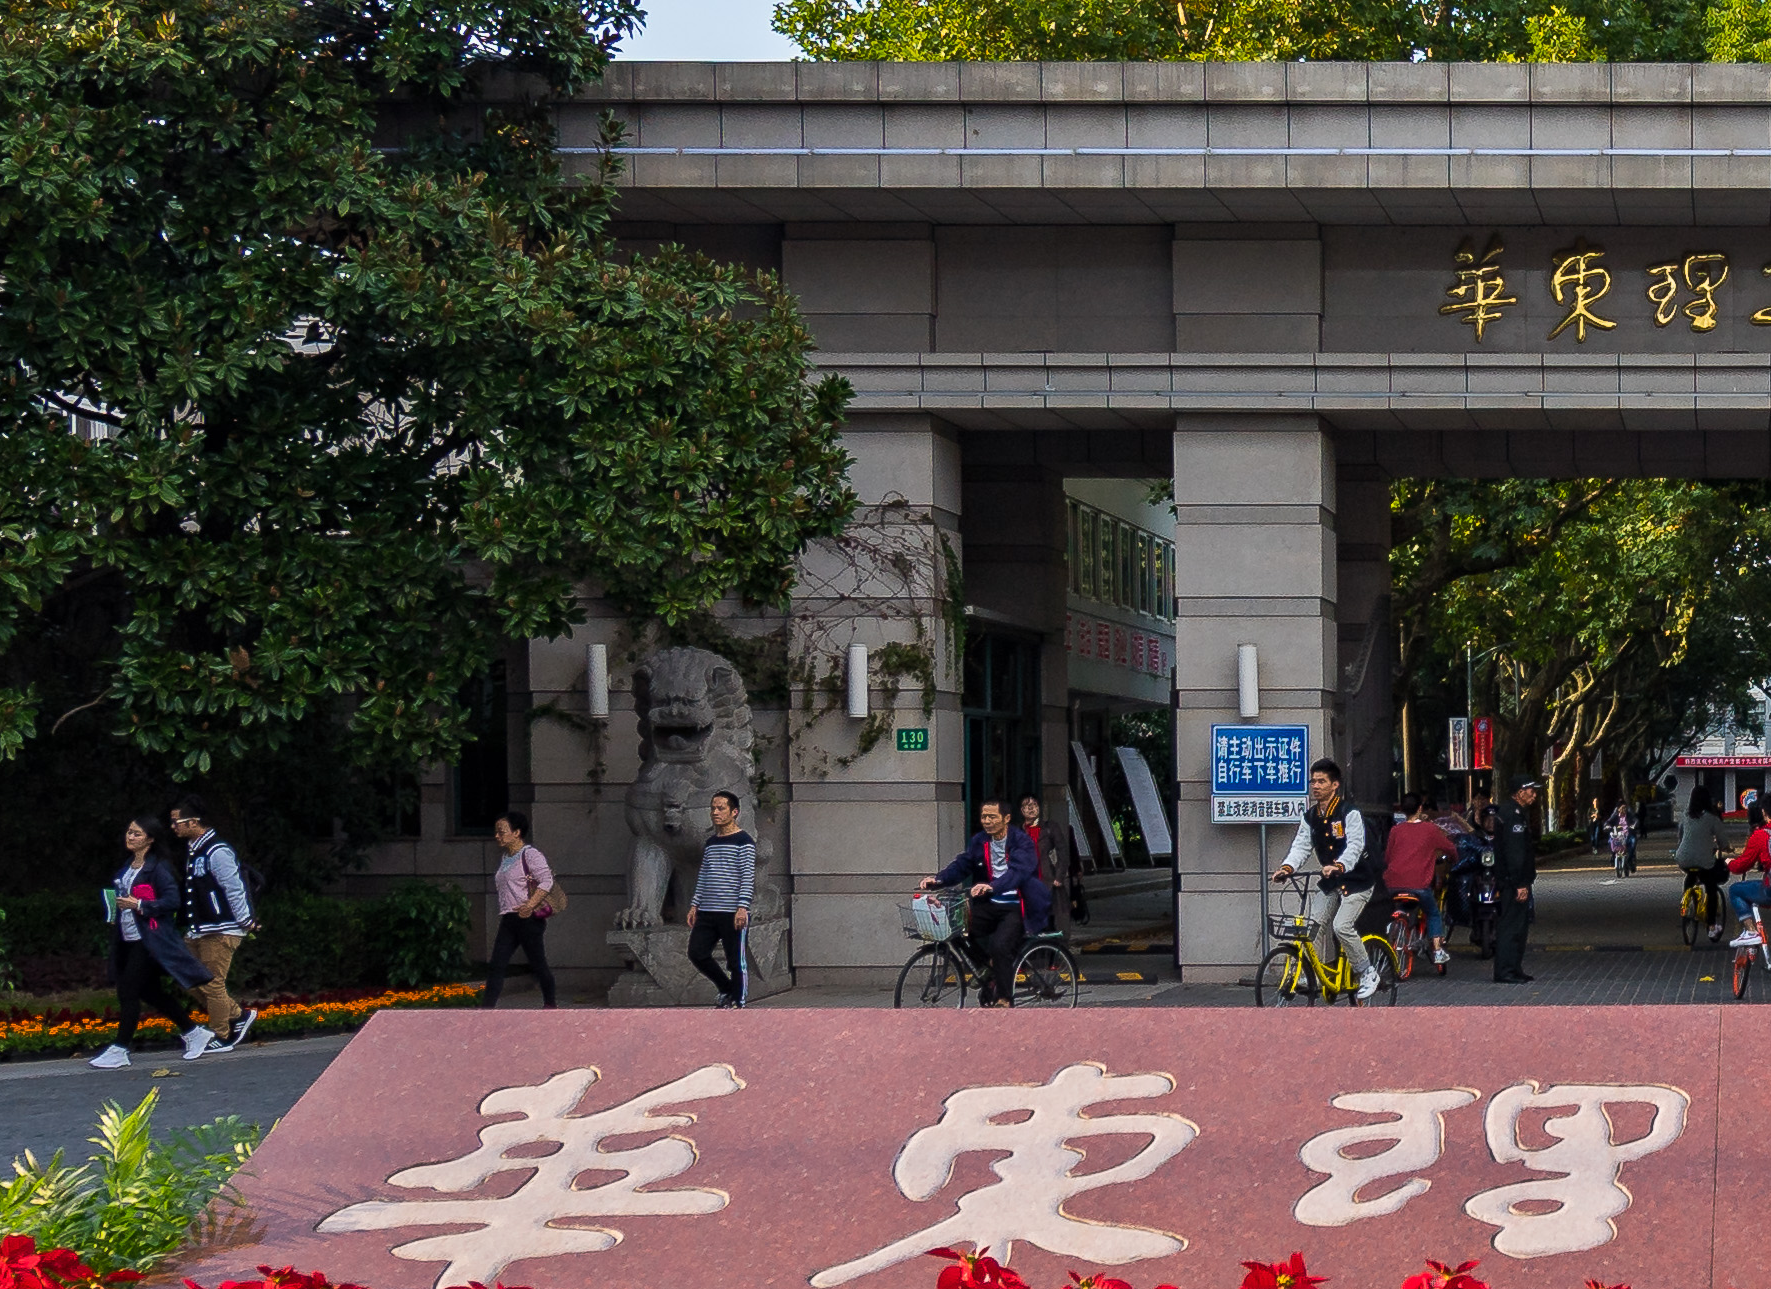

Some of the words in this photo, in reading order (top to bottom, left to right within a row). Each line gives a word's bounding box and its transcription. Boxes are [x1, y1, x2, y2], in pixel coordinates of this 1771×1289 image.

[901, 731, 924, 743] 130
[1217, 736, 1302, 760] 请主动出示证件
[1217, 760, 1302, 784] 自行车下车推行
